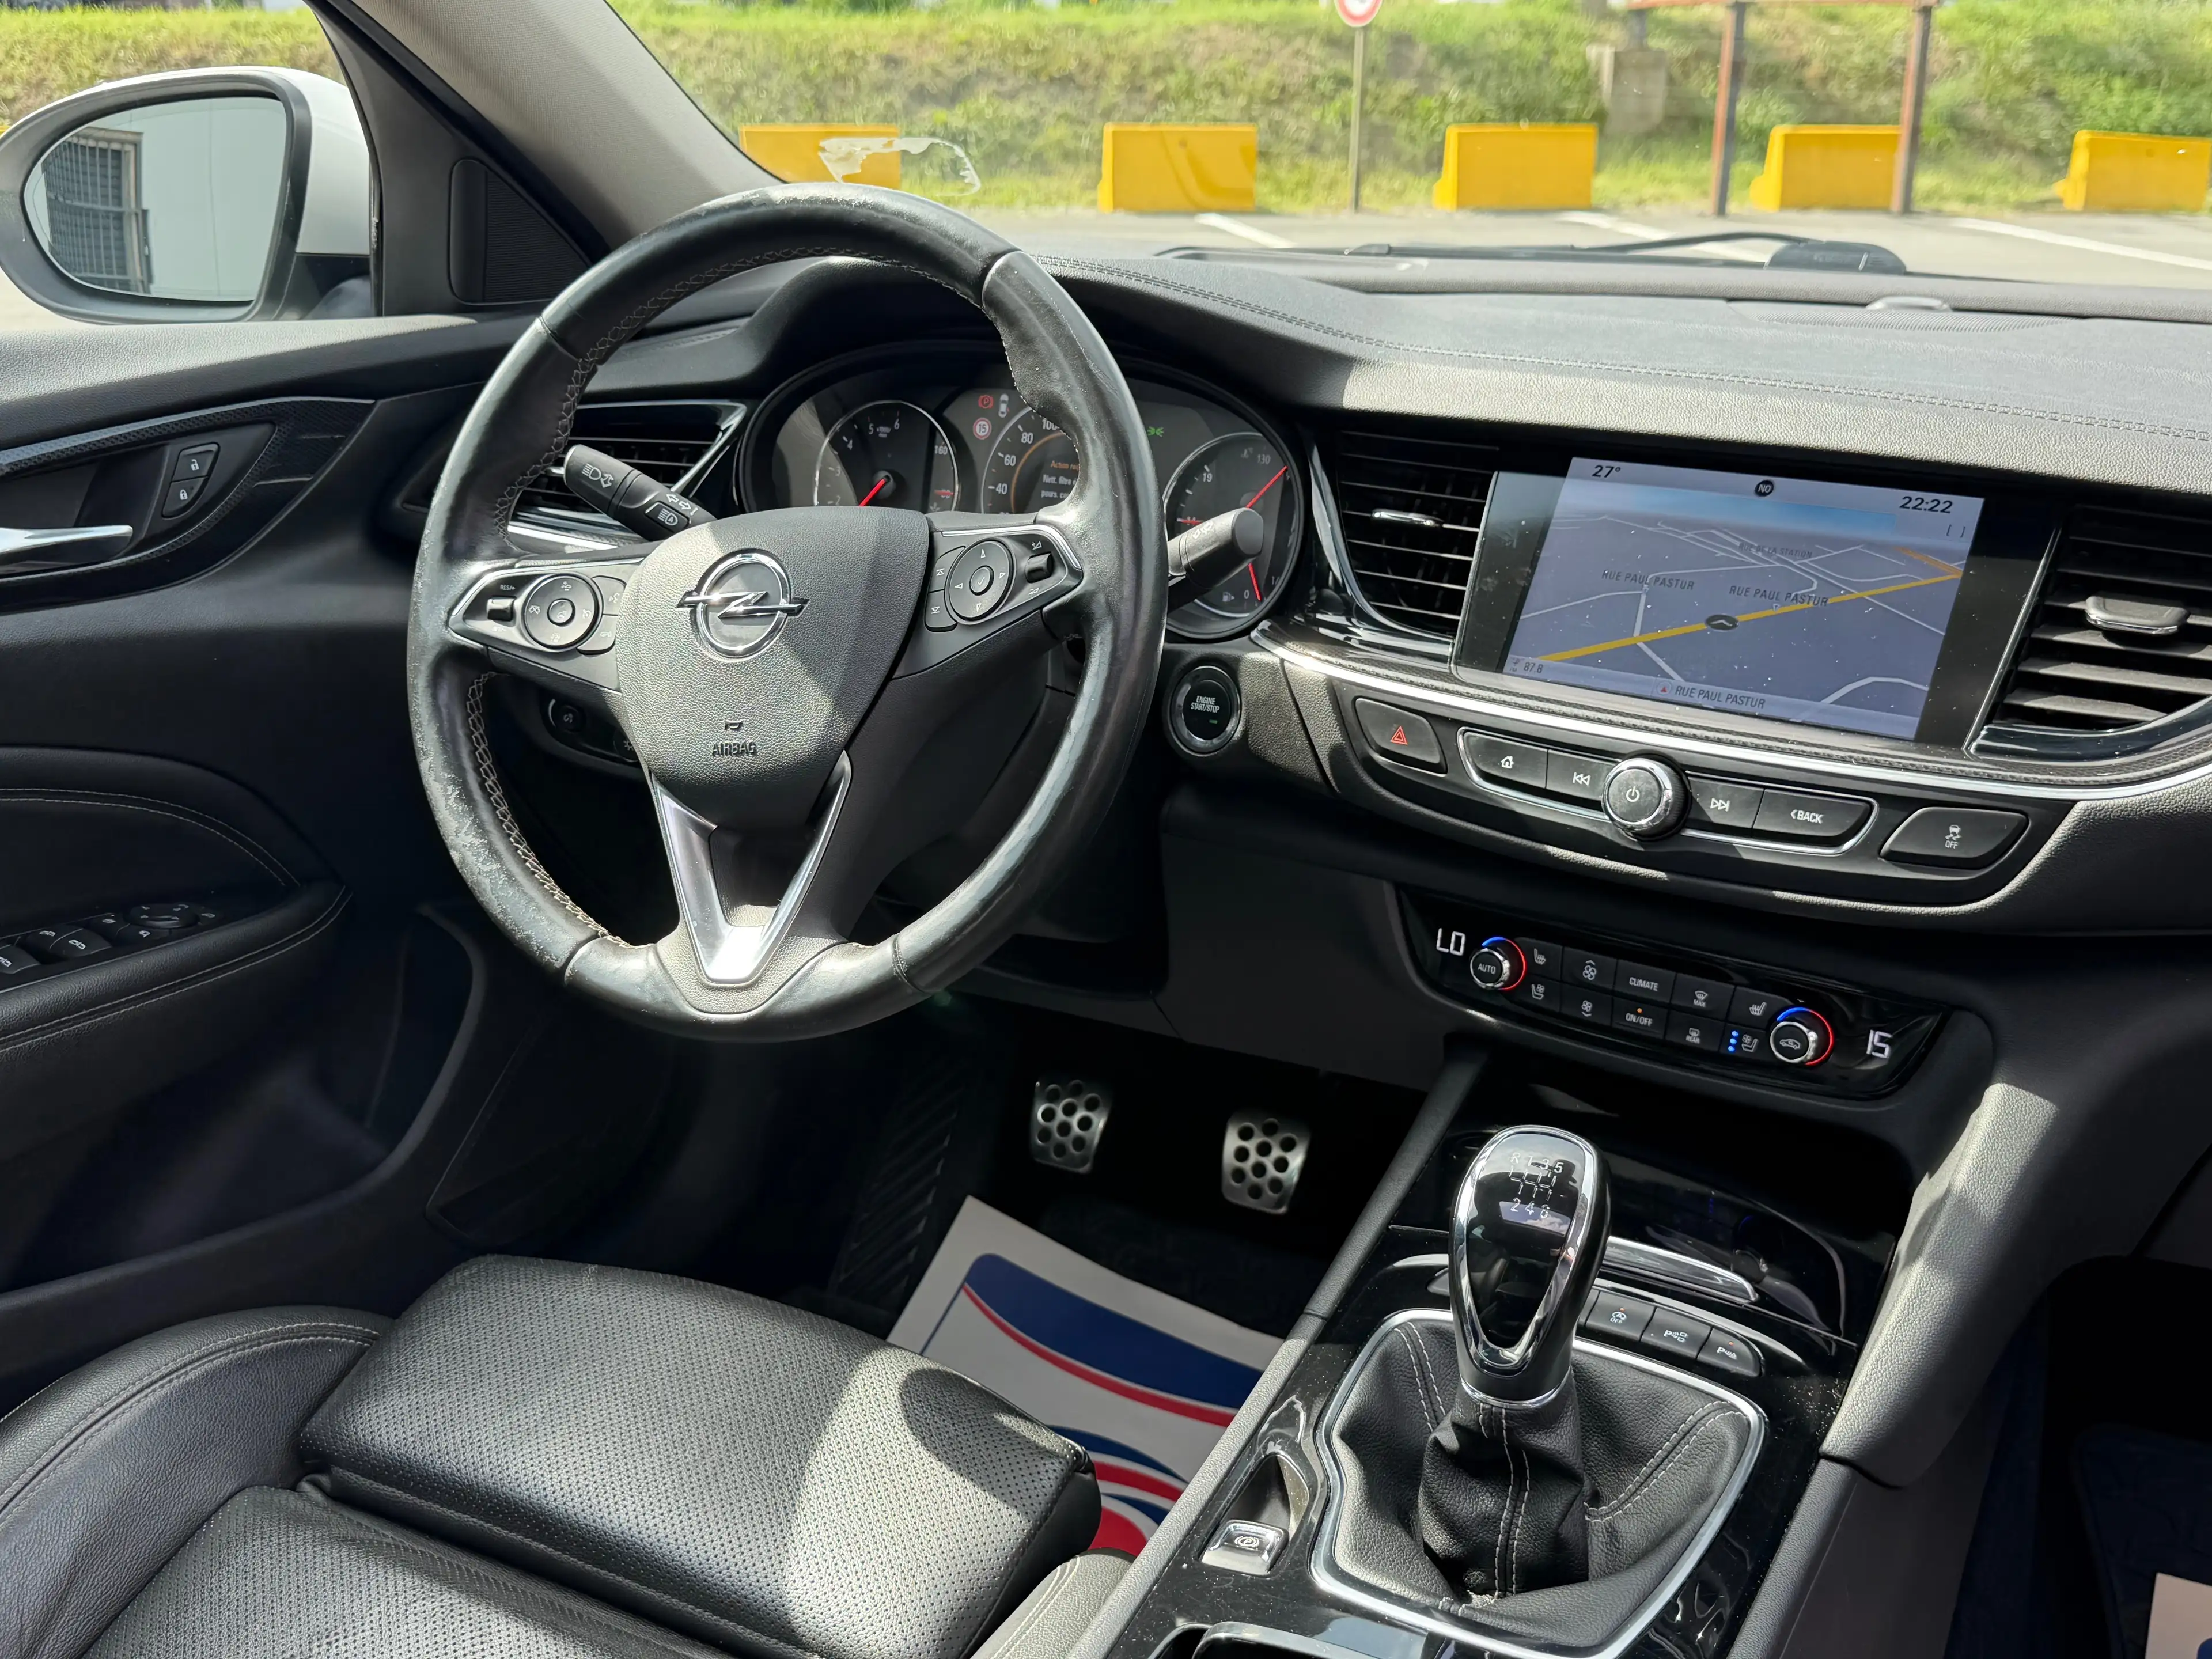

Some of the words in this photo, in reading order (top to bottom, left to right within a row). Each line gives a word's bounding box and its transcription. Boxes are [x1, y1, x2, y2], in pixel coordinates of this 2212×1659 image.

[869, 423, 874, 435] 5
[894, 418, 900, 430] 6
[978, 423, 987, 434] 15
[1021, 432, 1033, 444] 80
[847, 439, 853, 450] 4
[934, 445, 948, 455] 160
[1004, 455, 1016, 466] 60
[1257, 454, 1271, 465] 130
[1203, 472, 1213, 483] 19
[995, 483, 1008, 494] 40
[1758, 484, 1772, 493] NO
[1899, 495, 1953, 514] 22:22
[1738, 542, 1754, 552] RUE
[1779, 548, 1813, 558] STATION
[1601, 570, 1622, 581] RUE
[1624, 573, 1650, 585] PAUL
[1653, 576, 1695, 590] PASTUR
[1729, 585, 1751, 597] RUE
[1753, 588, 1780, 601] PAUL
[1784, 592, 1829, 607] PASTUR
[1196, 695, 1215, 705] ENGINE
[1675, 685, 1696, 698] RUE
[1698, 688, 1724, 703] PAUL
[1725, 693, 1766, 710] PASTUR
[1190, 702, 1220, 713] START/STOP
[712, 740, 757, 757] AIRBAG
[1945, 840, 1959, 849] OFF
[1478, 963, 1496, 975] AUTO
[1629, 977, 1659, 991] CLIMATE
[1694, 999, 1707, 1007] MAX
[1626, 1013, 1653, 1027] ON/OFF
[1686, 1035, 1700, 1044] REAR
[1510, 1152, 1521, 1164] R
[1541, 1158, 1550, 1169] 3
[1554, 1162, 1565, 1173] 5
[1510, 1197, 1521, 1212] 2
[1525, 1200, 1535, 1215] 4
[1540, 1204, 1550, 1219] 6
